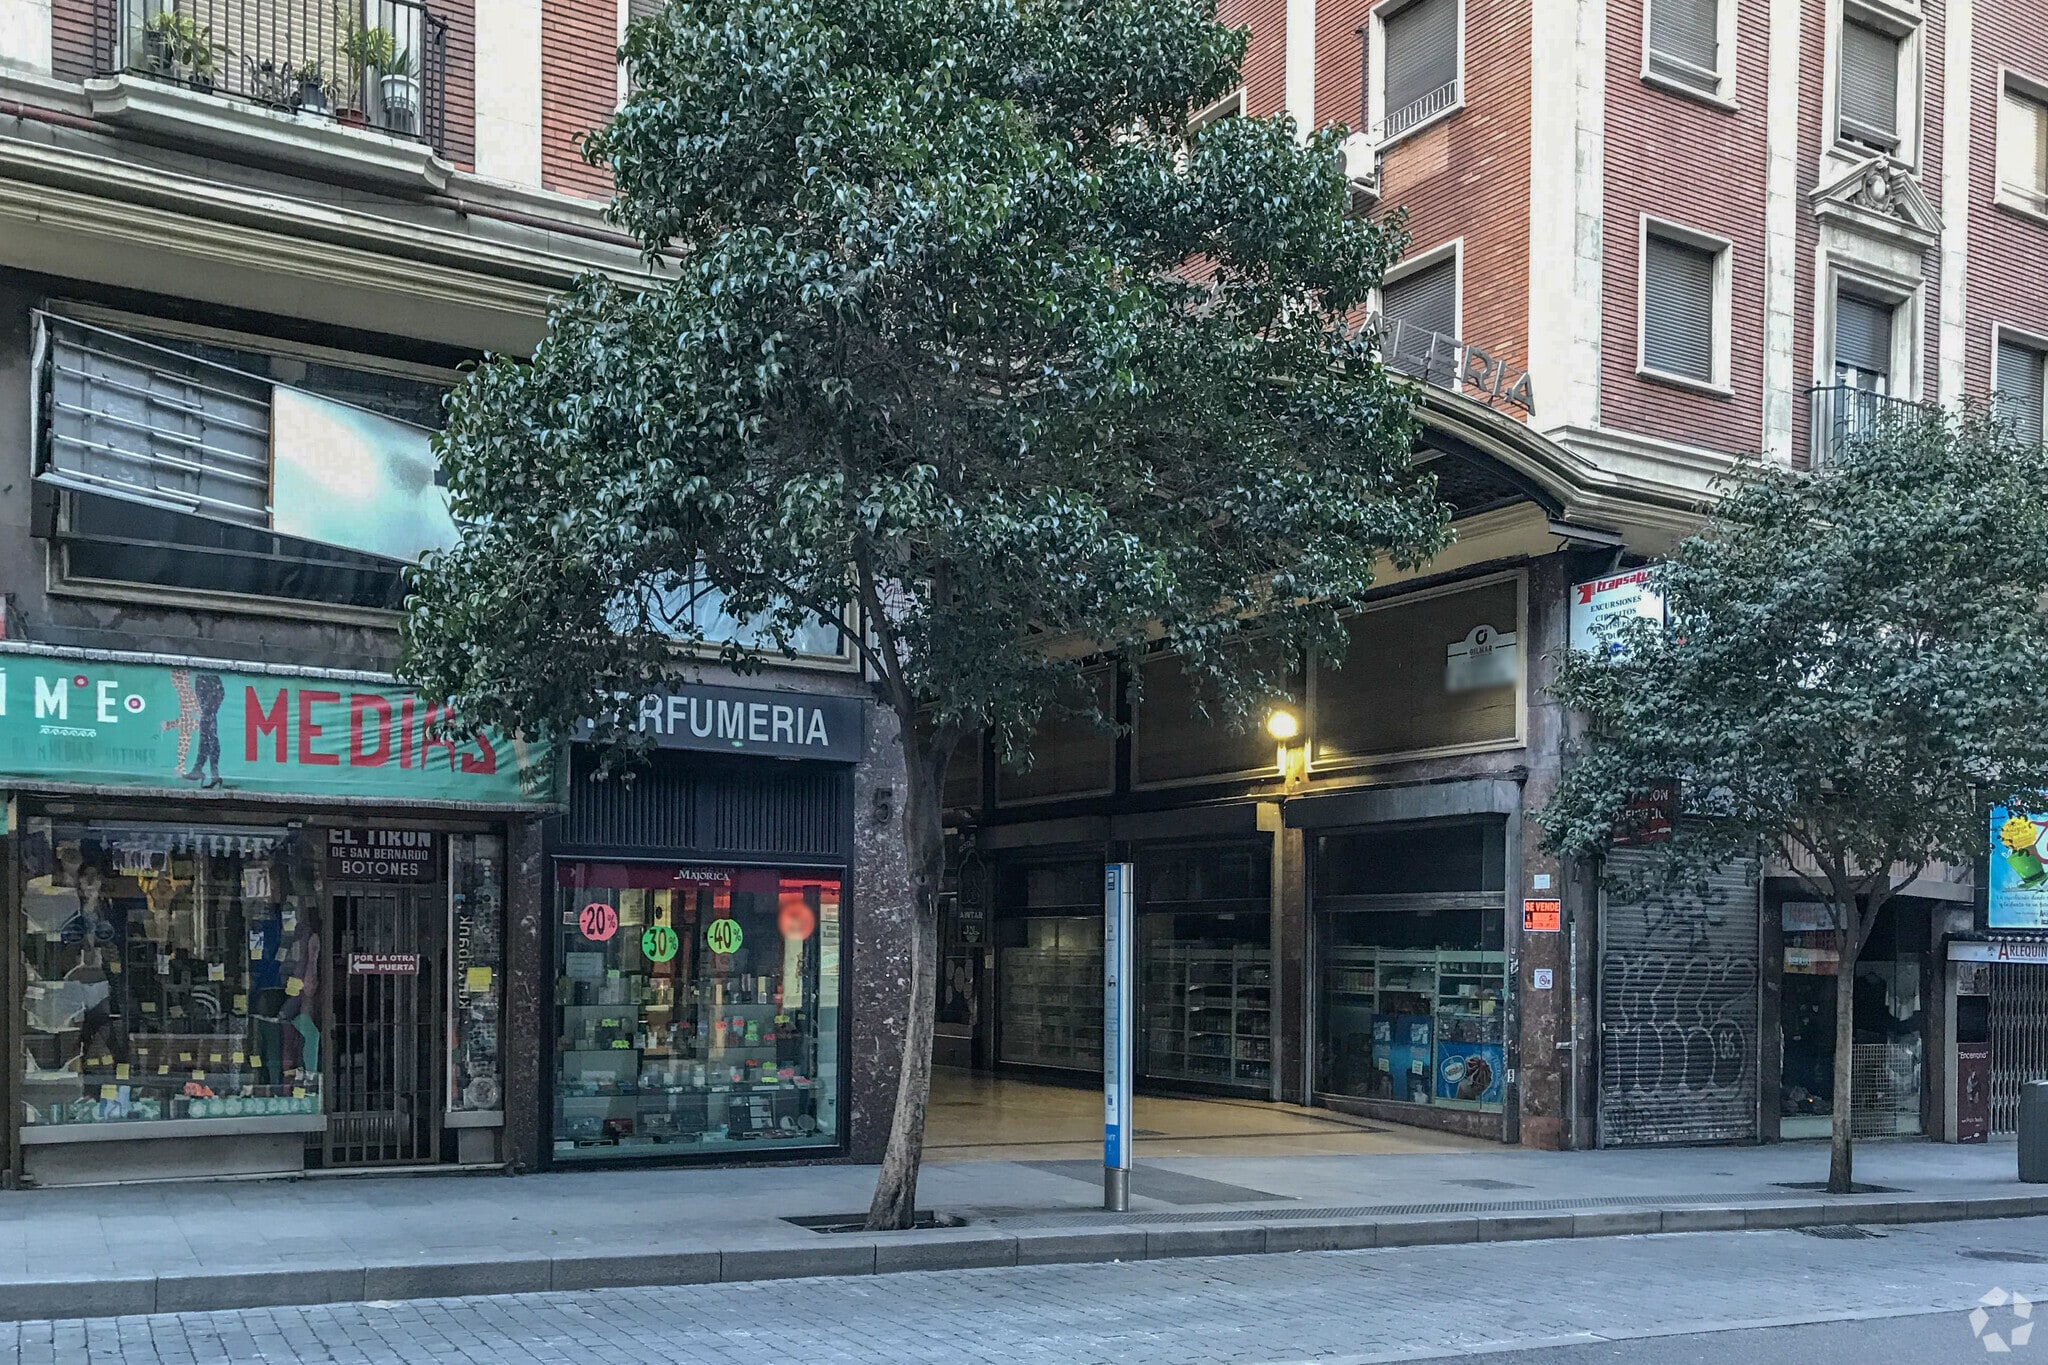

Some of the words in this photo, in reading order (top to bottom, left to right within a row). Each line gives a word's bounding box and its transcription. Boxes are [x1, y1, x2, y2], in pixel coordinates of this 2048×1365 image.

[1354, 310, 1536, 417] ALERIA
[1590, 594, 1642, 613] EXCURSIONES
[331, 847, 346, 858] DE
[350, 848, 370, 859] SAN
[374, 848, 428, 860] BERNARDO
[342, 860, 418, 876] BOTONES
[1525, 902, 1535, 912] SE
[1536, 902, 1559, 912] VENDE
